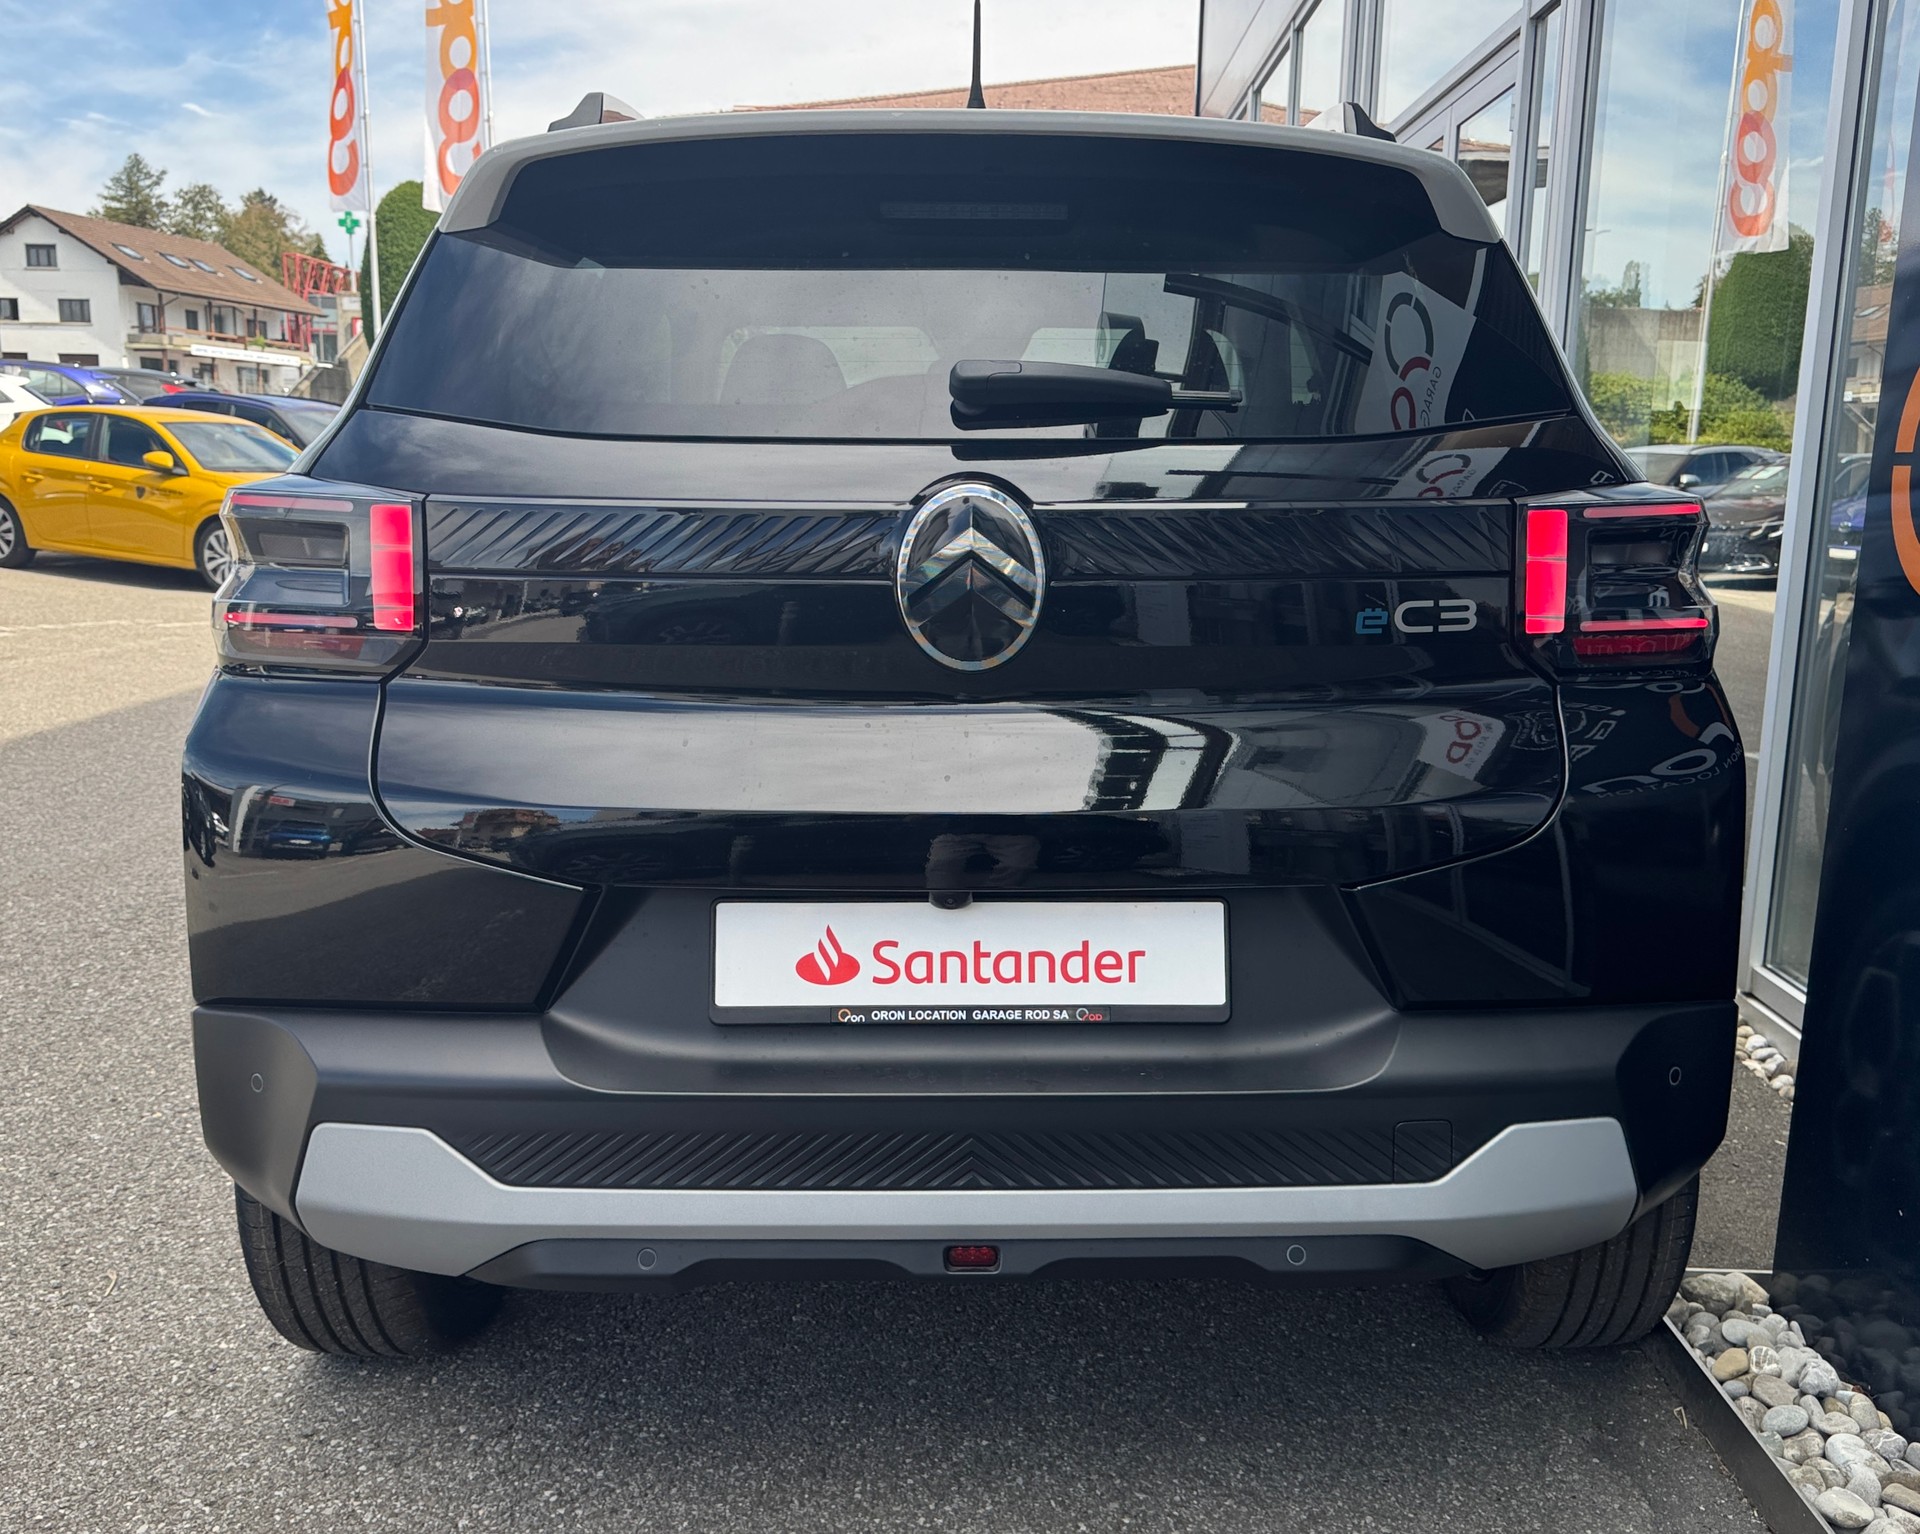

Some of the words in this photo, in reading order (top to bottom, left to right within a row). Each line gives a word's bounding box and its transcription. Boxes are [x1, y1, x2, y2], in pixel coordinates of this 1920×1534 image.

[871, 940, 1147, 985] Santander
[871, 1010, 906, 1021] ORON
[908, 1010, 967, 1021] LOCATION
[972, 1010, 1022, 1021] GARAGE
[1025, 1010, 1050, 1021] ROD
[1052, 1010, 1069, 1021] SA
